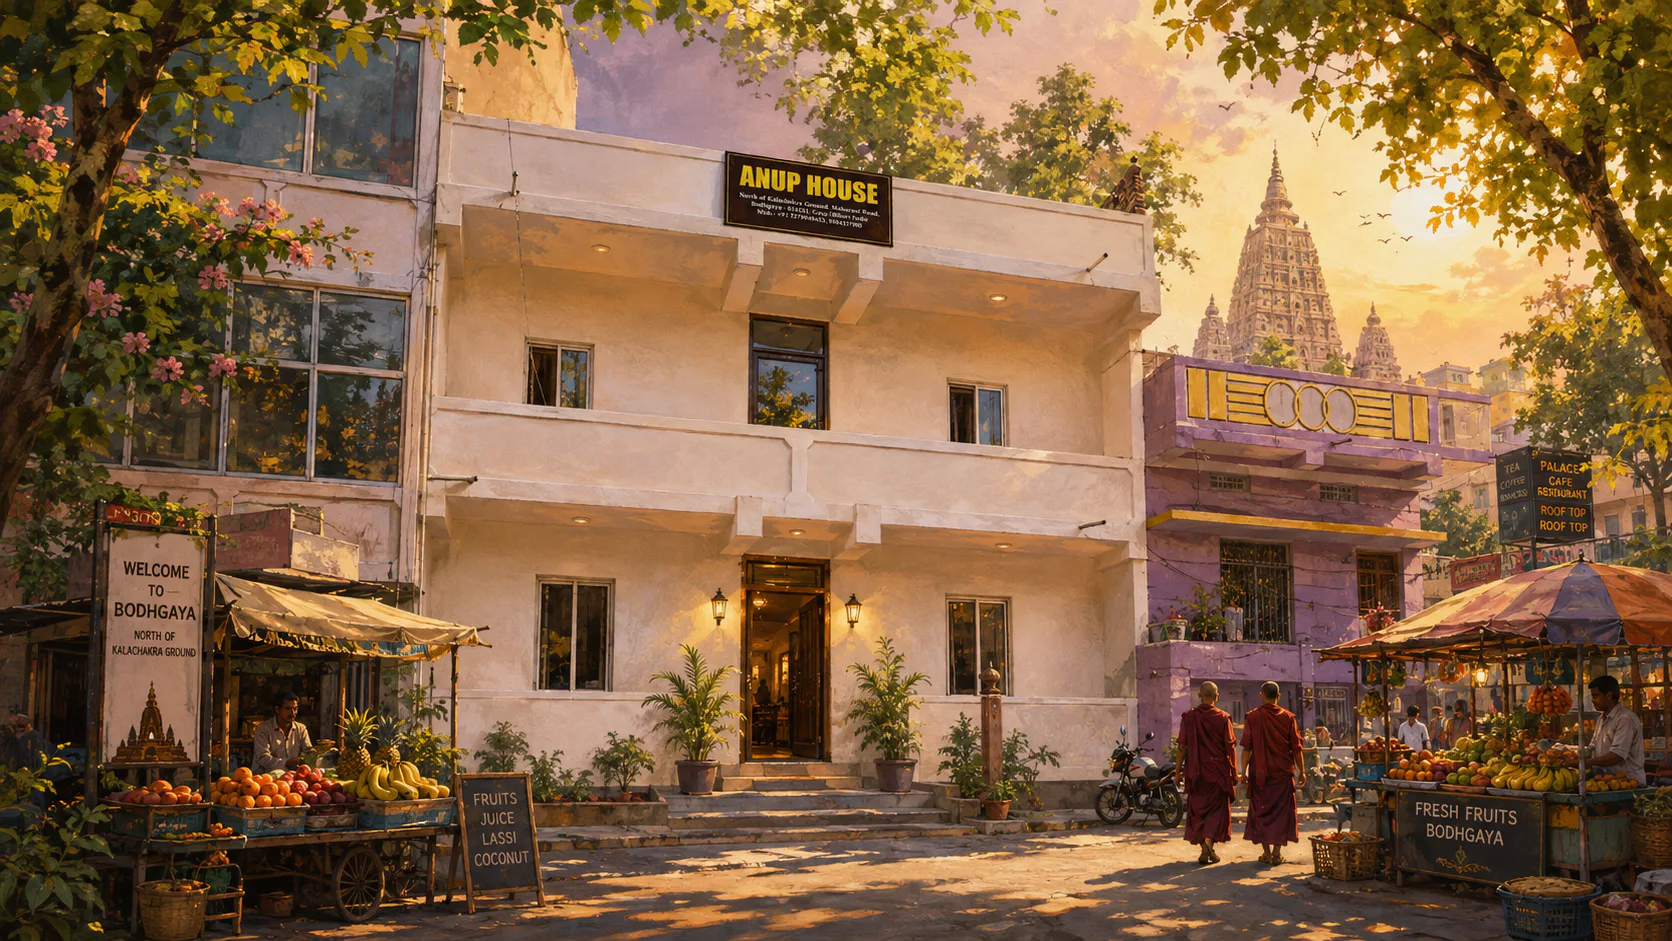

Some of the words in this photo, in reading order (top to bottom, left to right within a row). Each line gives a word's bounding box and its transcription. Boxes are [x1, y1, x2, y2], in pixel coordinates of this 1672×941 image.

[739, 165, 801, 193] ANUP
[807, 174, 879, 205] HOUSE
[1504, 462, 1520, 474] TEA
[1540, 461, 1579, 474] PALACE
[1548, 476, 1572, 487] CAFE
[1540, 505, 1566, 516] ROOF
[1568, 507, 1586, 518] TOP
[1540, 520, 1566, 532] ROOF
[1569, 522, 1588, 533] TOP
[123, 561, 190, 579] WELCOME
[148, 584, 164, 597] TO
[114, 602, 196, 620] BODHGAYA
[134, 630, 162, 641] NORTH
[164, 632, 175, 641] OF
[112, 645, 163, 656] KALACHAKRA
[165, 647, 197, 657] GROUND
[473, 792, 518, 806] FRUITS
[480, 812, 515, 826] JUICE
[1415, 802, 1459, 820] FRESH
[1465, 806, 1517, 826] FRUITS
[482, 831, 517, 846] LASSI
[1426, 823, 1504, 846] BODHGAYA
[474, 850, 529, 867] COCONUT
